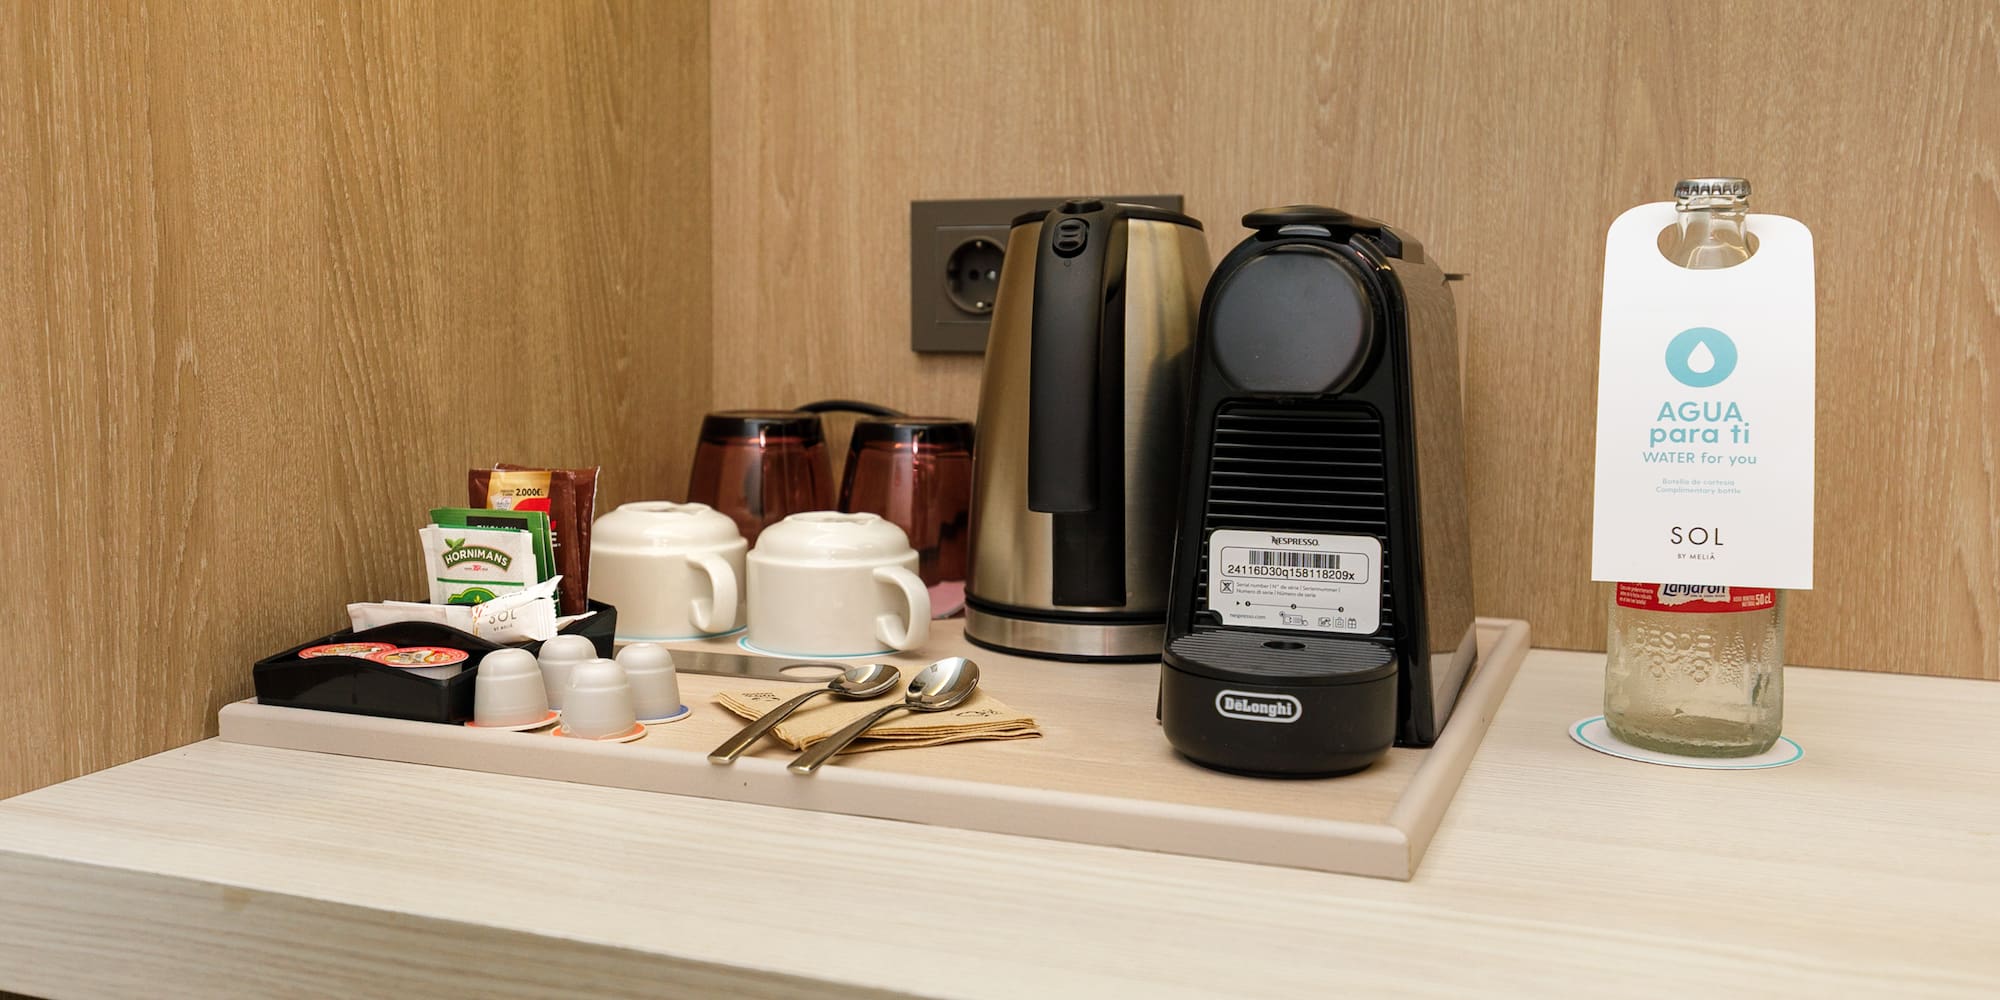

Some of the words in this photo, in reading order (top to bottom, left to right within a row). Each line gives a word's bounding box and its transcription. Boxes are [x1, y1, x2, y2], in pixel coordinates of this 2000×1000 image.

[1656, 401, 1743, 422] AGUA
[1650, 428, 1719, 448] para
[1730, 422, 1750, 444] ti
[1642, 452, 1695, 463] WATER
[1701, 452, 1723, 464] for
[1729, 454, 1757, 467] you
[1656, 486, 1716, 495] Complimentary
[1271, 536, 1319, 546] NESPRESSO
[1670, 526, 1724, 546] SOL
[444, 549, 508, 567] HORNIMANS
[1227, 564, 1355, 581] 24116D30q158118209x
